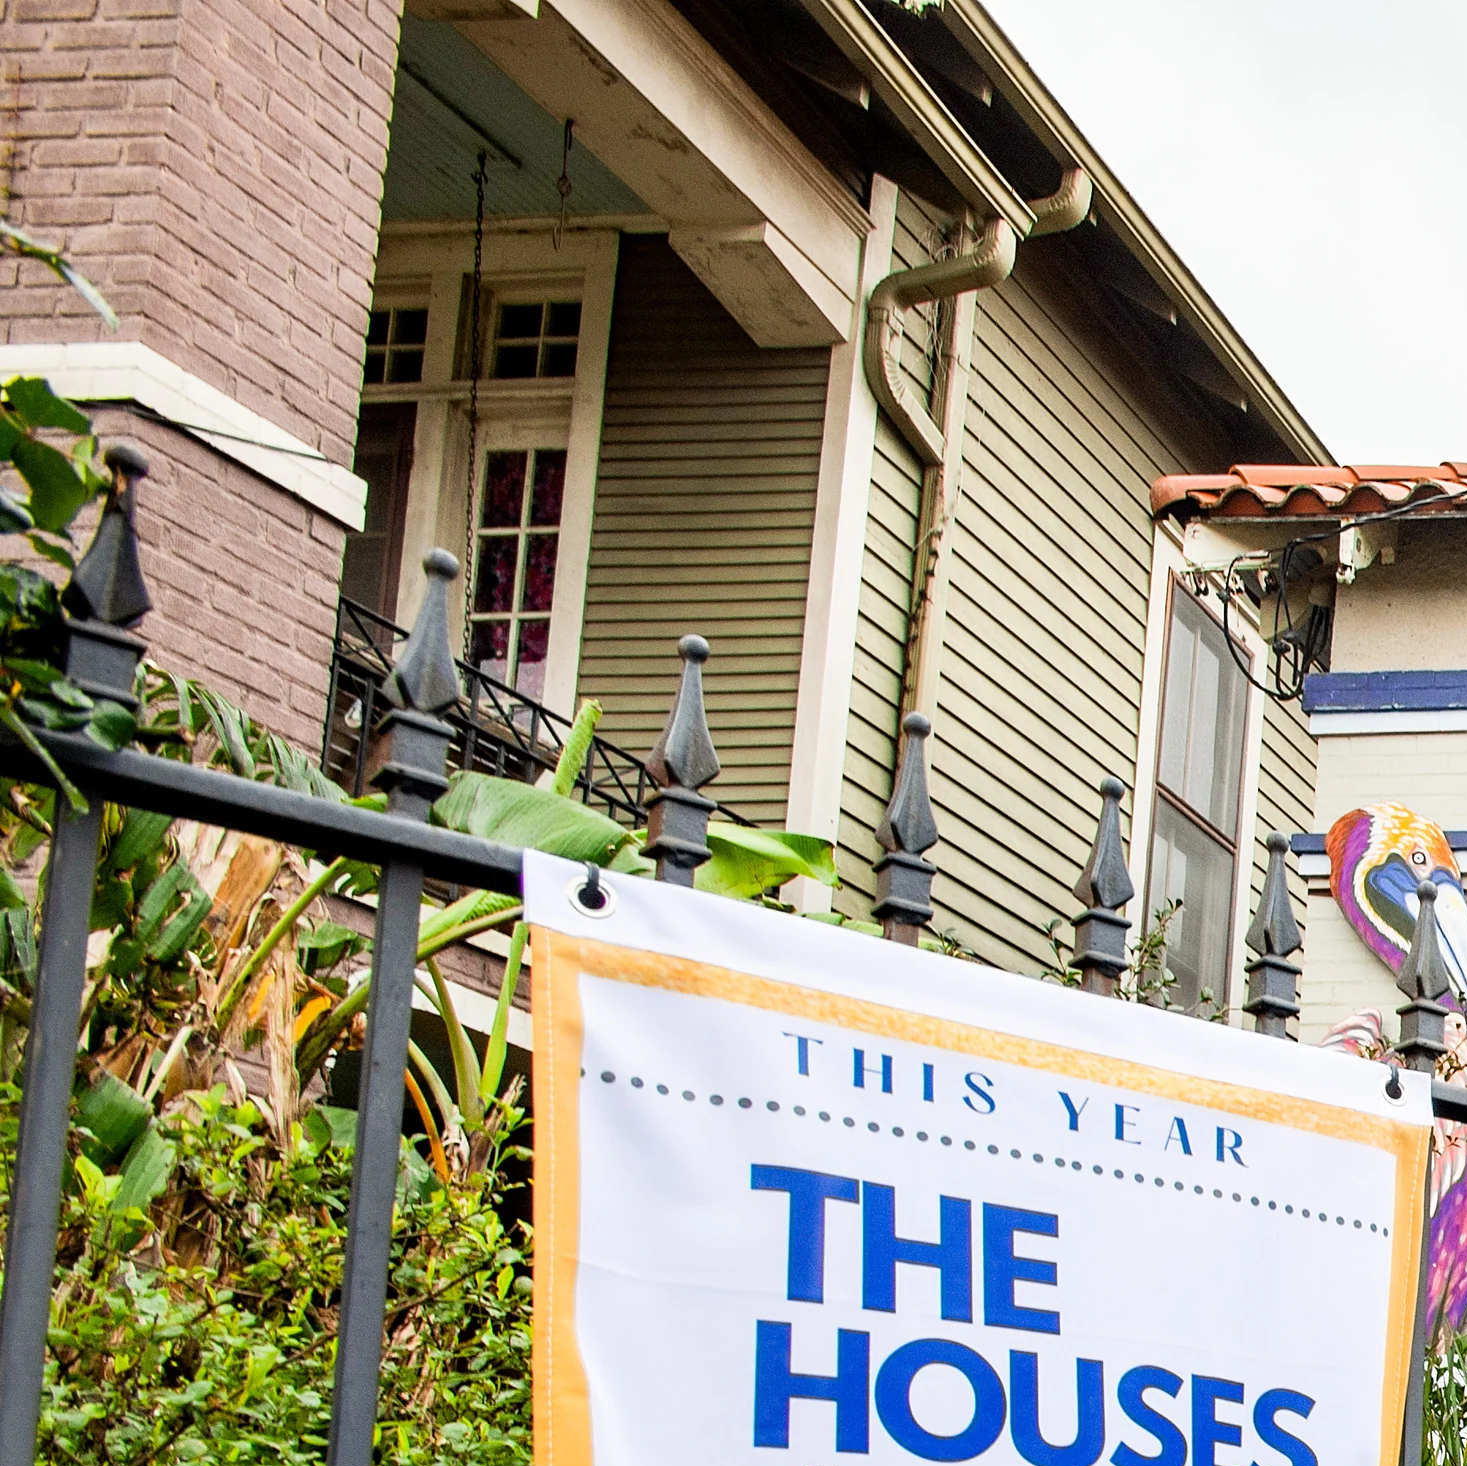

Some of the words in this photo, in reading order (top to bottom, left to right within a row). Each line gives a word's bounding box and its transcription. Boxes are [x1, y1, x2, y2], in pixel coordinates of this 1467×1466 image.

[782, 1031, 998, 1116] THIS
[1056, 1090, 1252, 1168] YEAR
[749, 1162, 1062, 1336] THE
